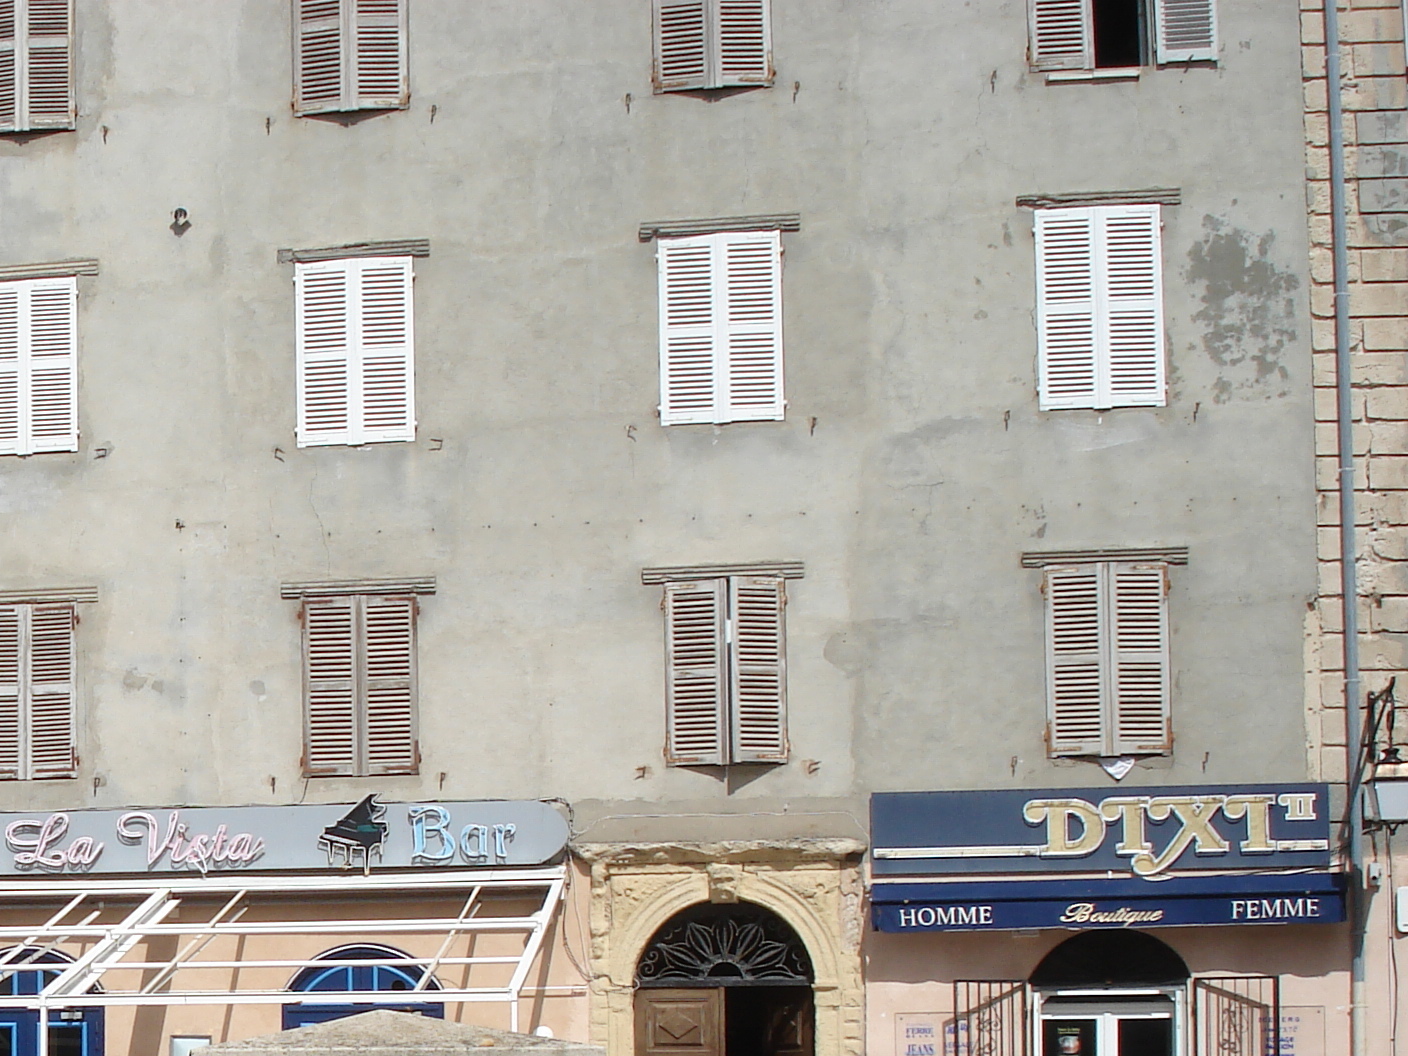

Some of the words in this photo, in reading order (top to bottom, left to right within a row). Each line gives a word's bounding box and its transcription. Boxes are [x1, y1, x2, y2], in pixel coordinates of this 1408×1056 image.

[6, 812, 104, 868] La
[115, 810, 265, 879] Vista
[408, 804, 517, 861] Bar
[899, 906, 993, 927] HOMME
[1059, 902, 1165, 928] Boutique
[1231, 898, 1321, 919] FEMME
